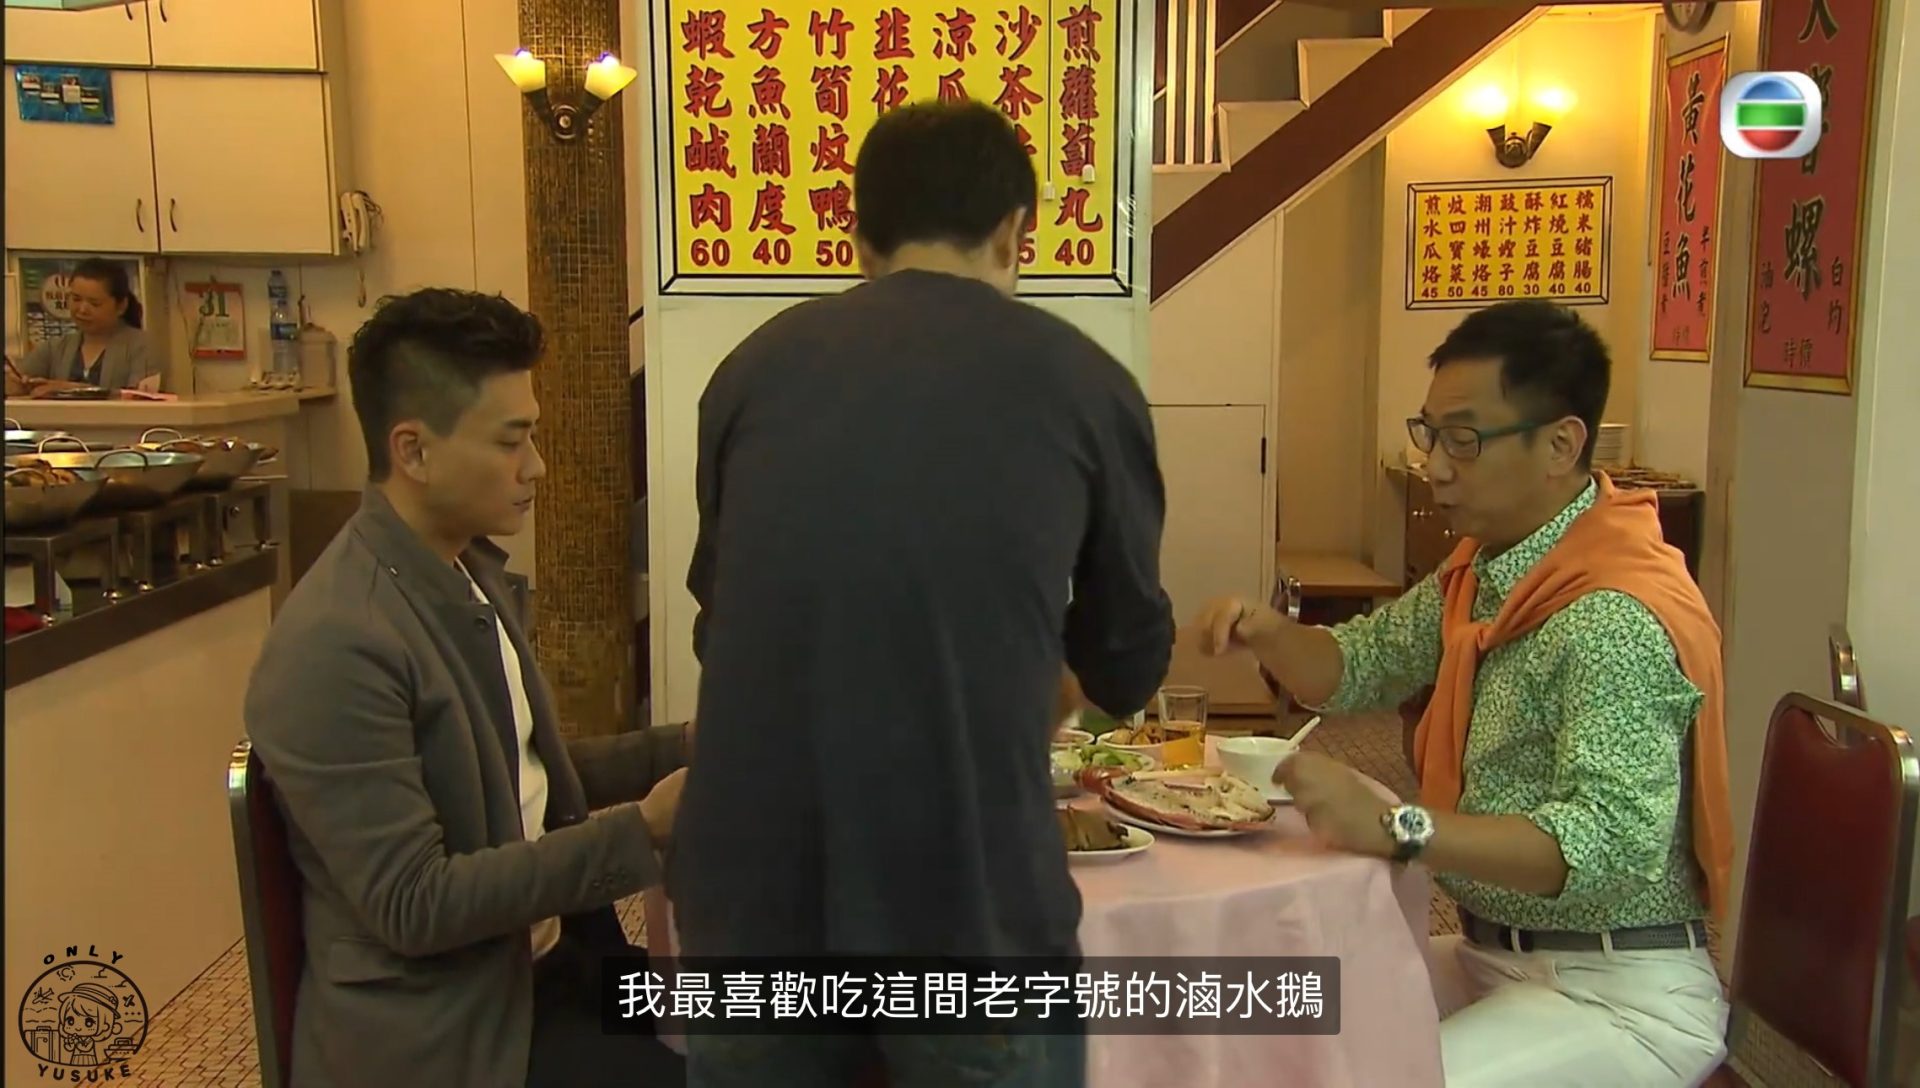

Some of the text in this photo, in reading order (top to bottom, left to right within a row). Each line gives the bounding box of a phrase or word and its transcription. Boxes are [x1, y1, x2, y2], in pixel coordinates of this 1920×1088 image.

[746, 8, 796, 266] 方魚蘭度 40
[808, 8, 857, 267] 竹筍炆鴨 50
[690, 238, 730, 267] 60
[1019, 237, 1036, 264] 5
[1054, 238, 1095, 266] 40
[1421, 194, 1442, 298] 煎水瓜烙 45
[1523, 191, 1544, 295] 酥炸豆腐 30
[1548, 192, 1569, 295] 紅燒豆腐 40
[1447, 286, 1464, 297] 50
[1471, 285, 1489, 297] 45
[1574, 282, 1592, 294] 40
